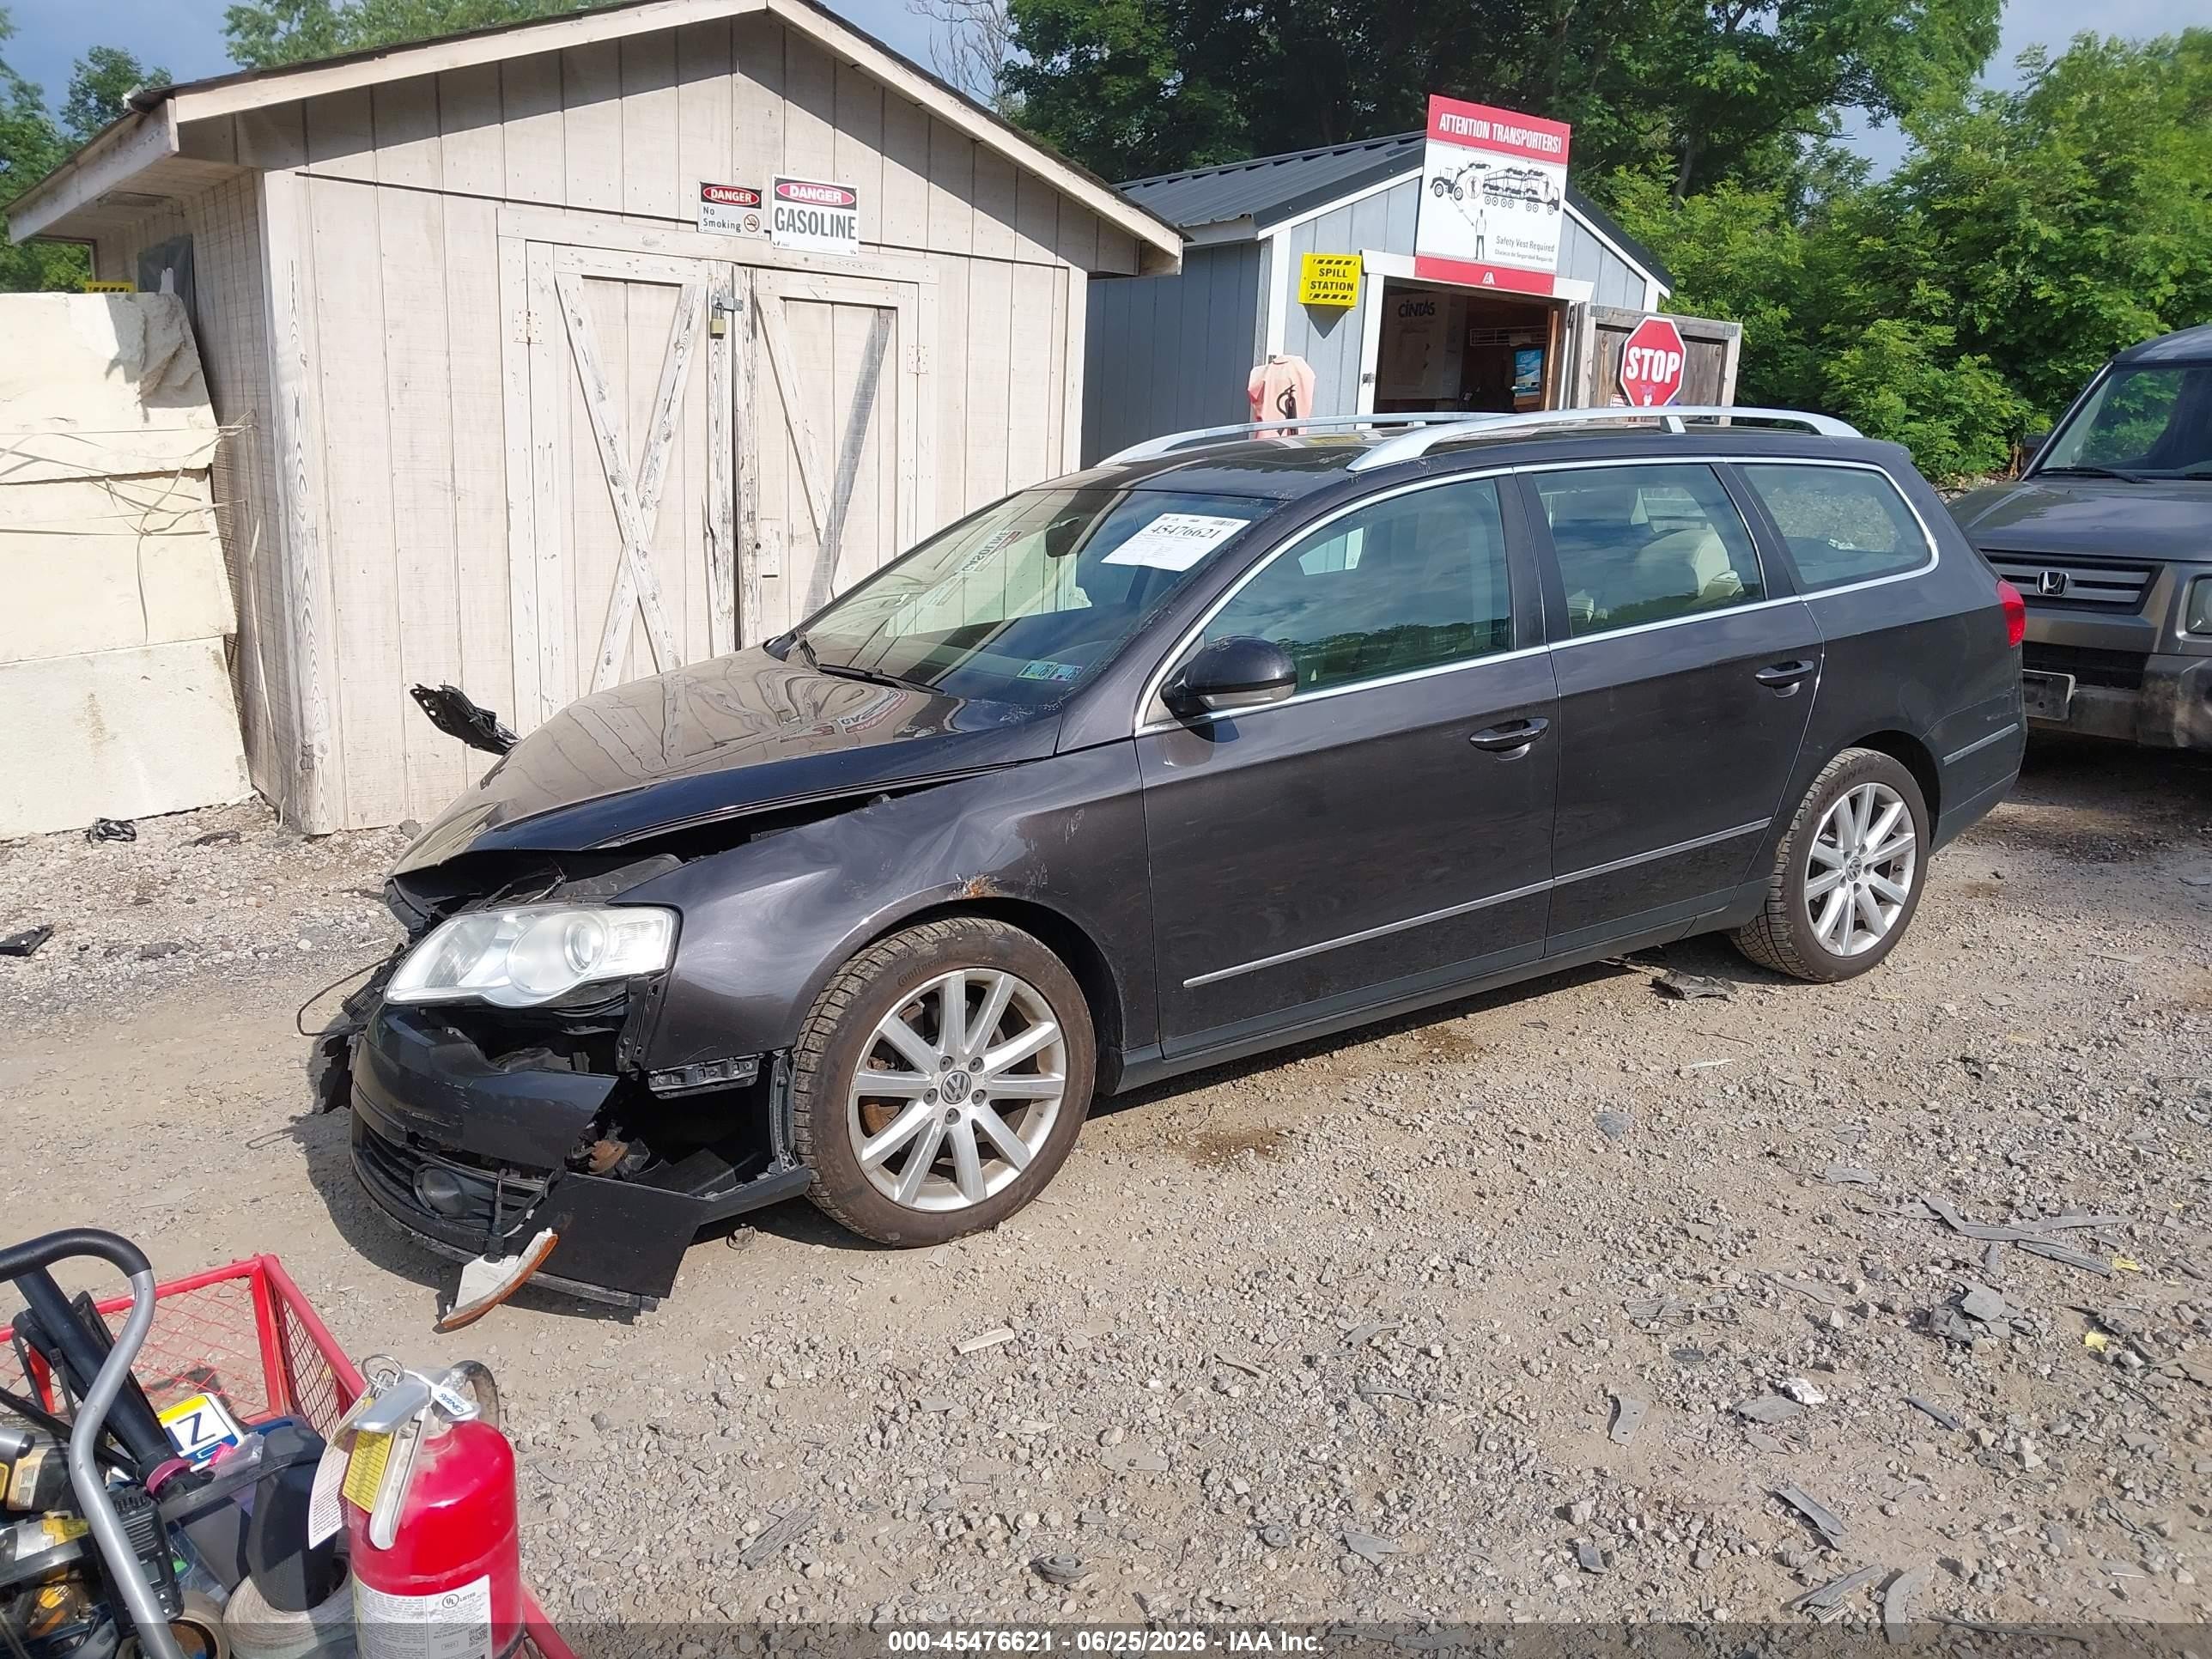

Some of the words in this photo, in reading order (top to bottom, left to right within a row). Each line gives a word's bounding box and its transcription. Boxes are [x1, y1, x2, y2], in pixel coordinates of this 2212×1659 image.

[1439, 113, 1490, 139] ATTENTION
[1492, 123, 1562, 155] TRANSPORTERS!
[710, 187, 752, 204] DANGER
[789, 185, 842, 204] DANGER
[702, 206, 715, 216] No
[702, 217, 742, 233] Smoking
[775, 207, 857, 240] GASOLINE
[1496, 235, 1515, 248] Safety
[1516, 238, 1529, 249] Vest
[1529, 240, 1555, 253] Required
[1319, 267, 1348, 278] SPILL
[1310, 280, 1354, 292] STATION
[1626, 346, 1680, 385] STOP
[1151, 525, 1222, 539] 45476621
